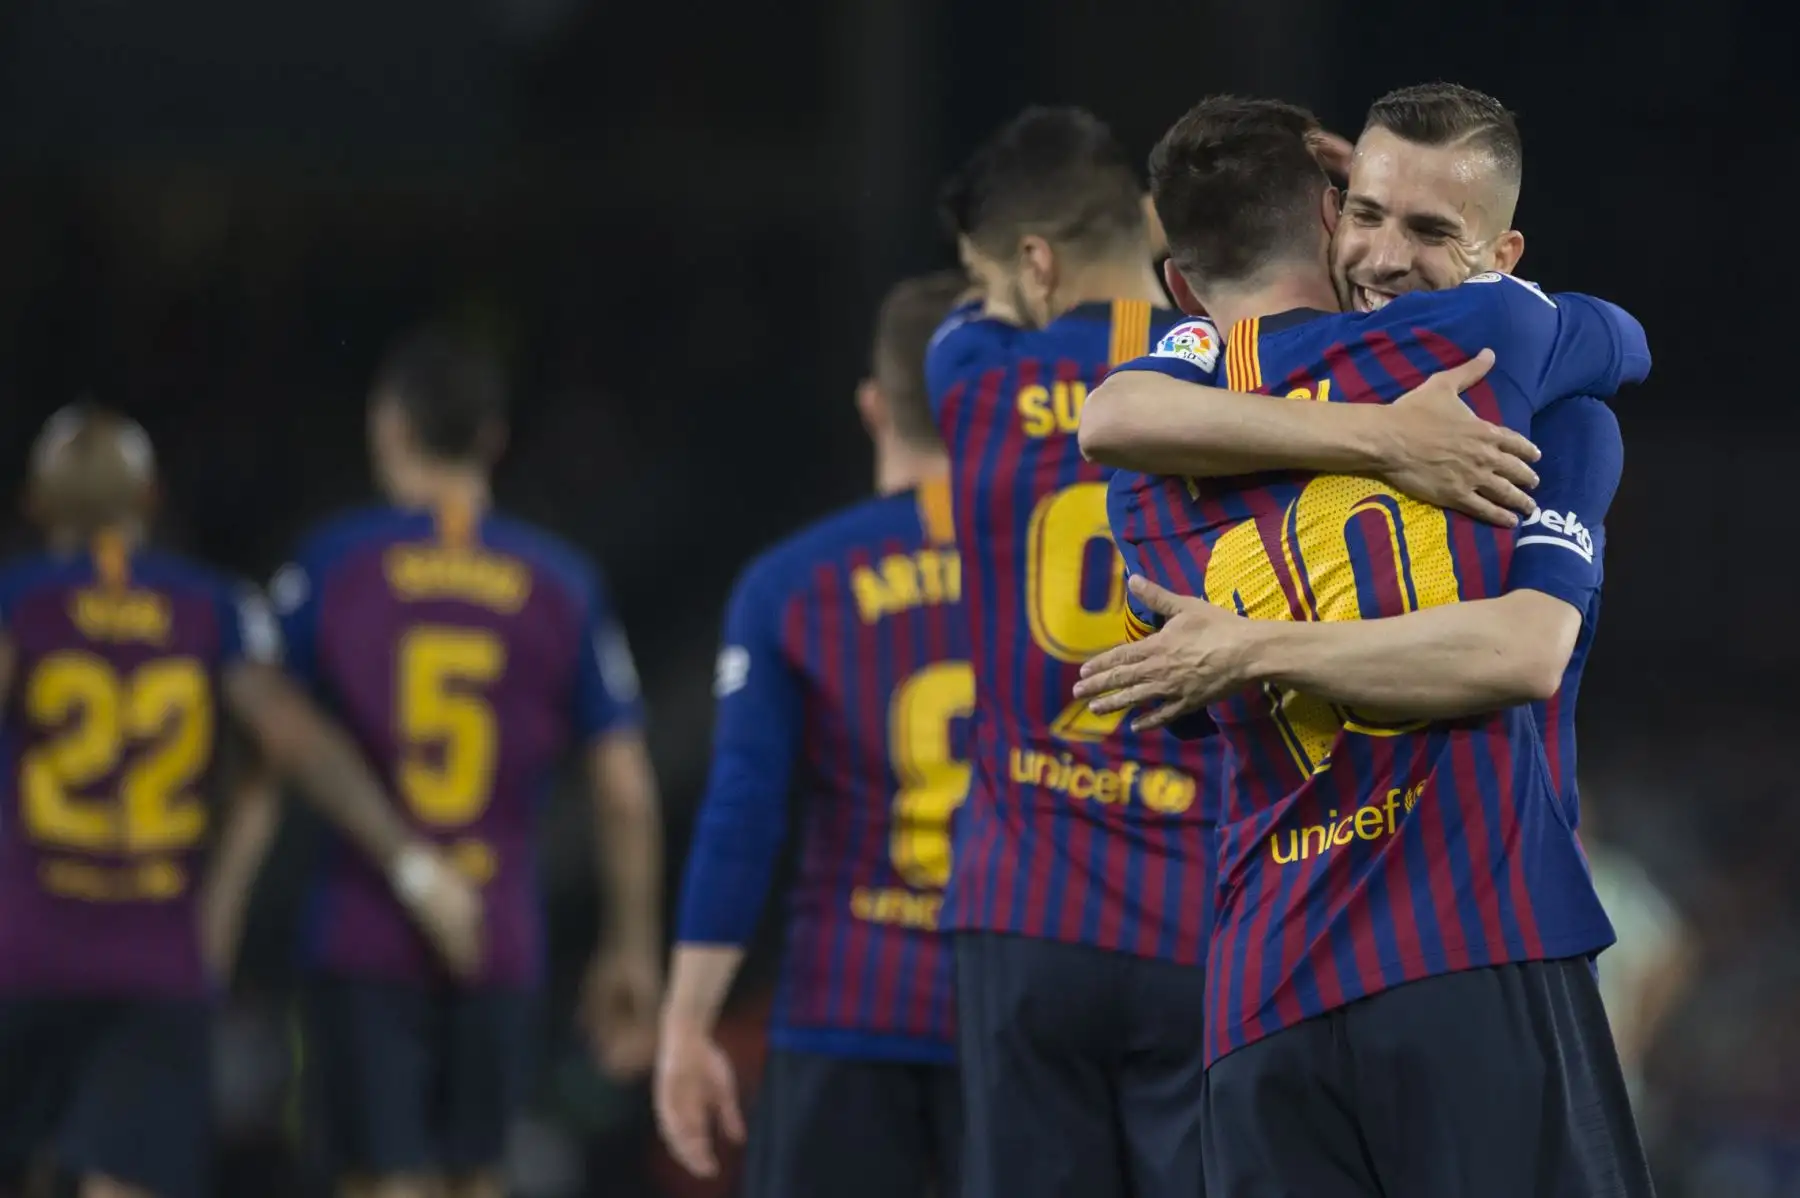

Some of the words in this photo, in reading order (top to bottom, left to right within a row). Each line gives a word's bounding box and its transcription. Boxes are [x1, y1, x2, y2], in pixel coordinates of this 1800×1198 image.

[22, 652, 211, 851] 22
[399, 623, 502, 826] 5
[1009, 747, 1140, 806] unicef
[1271, 788, 1401, 865] unicef
